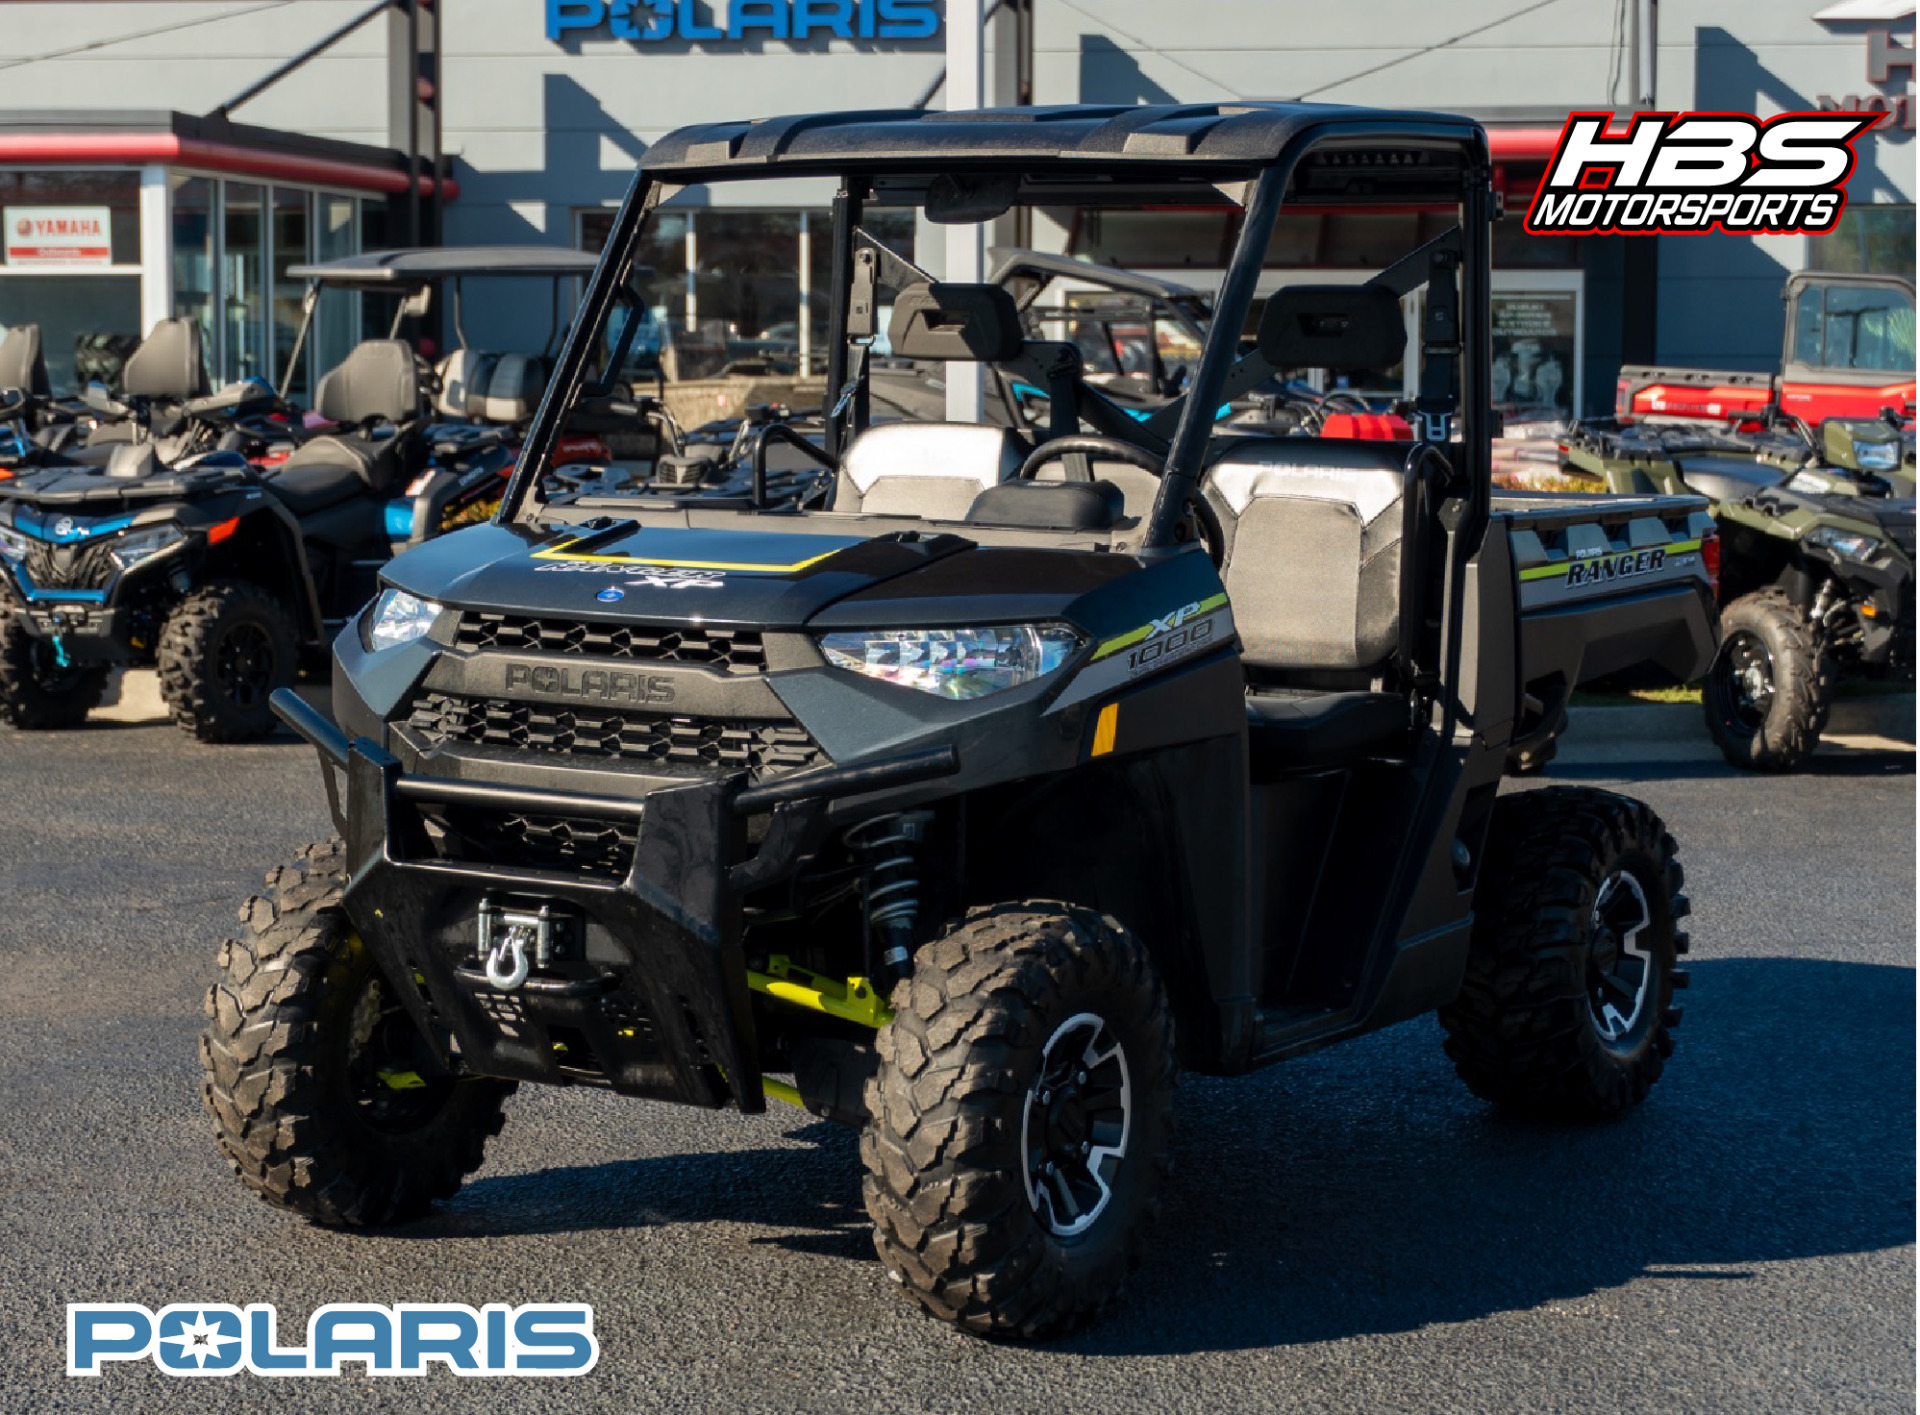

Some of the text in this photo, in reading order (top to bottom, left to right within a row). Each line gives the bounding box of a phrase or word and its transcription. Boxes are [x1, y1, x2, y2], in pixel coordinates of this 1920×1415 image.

[546, 0, 939, 40] POLARIS
[35, 219, 100, 235] YAMAHA
[624, 575, 725, 589] XP
[1565, 548, 1667, 589] RANGER
[1145, 601, 1201, 640] XP
[1127, 618, 1213, 672] 1000
[505, 662, 676, 705] POLARIS
